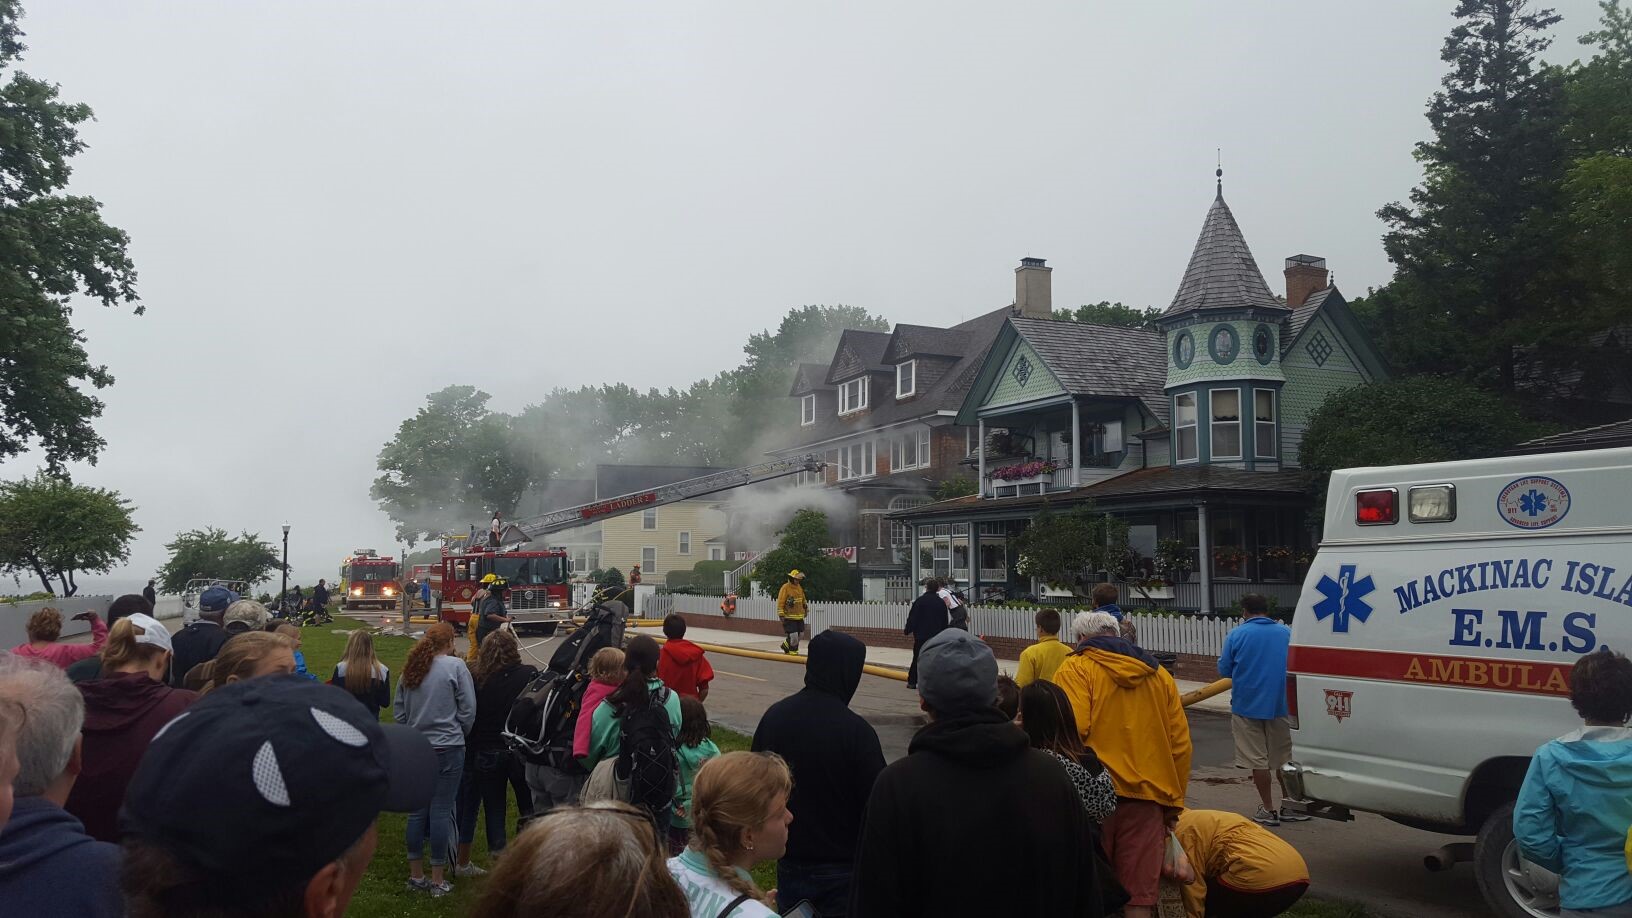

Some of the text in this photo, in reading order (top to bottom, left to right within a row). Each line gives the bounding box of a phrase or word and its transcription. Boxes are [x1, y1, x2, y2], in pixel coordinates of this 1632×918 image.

[609, 496, 643, 510] LADDER
[1393, 558, 1553, 614] MACKINAC
[1449, 608, 1609, 654] E.M.S.
[1404, 658, 1570, 692] AMBULA
[1327, 695, 1349, 711] 911
